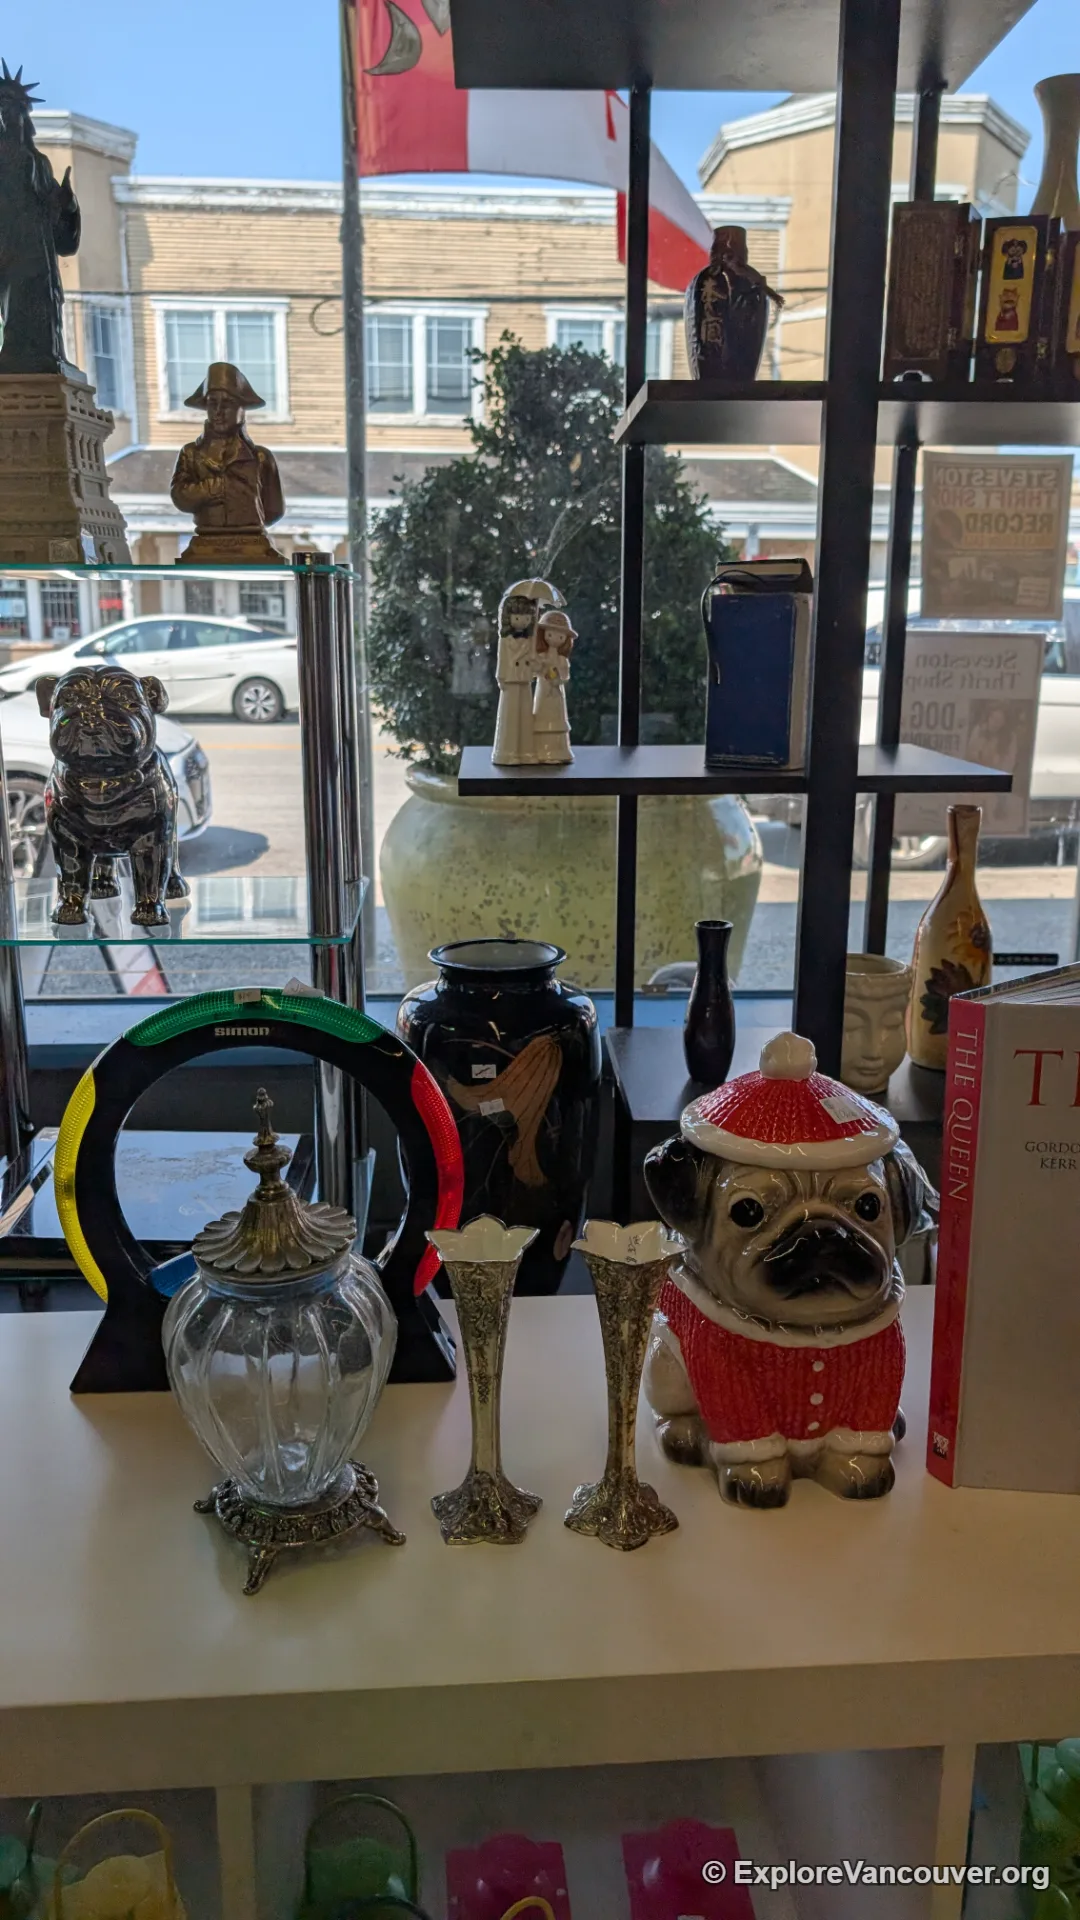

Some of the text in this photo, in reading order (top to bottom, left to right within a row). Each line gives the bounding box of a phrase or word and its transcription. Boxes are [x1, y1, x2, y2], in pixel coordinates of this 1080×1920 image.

[954, 1028, 978, 1089] THE
[947, 1097, 974, 1202] QUEEN
[1040, 1157, 1077, 1170] KERR
